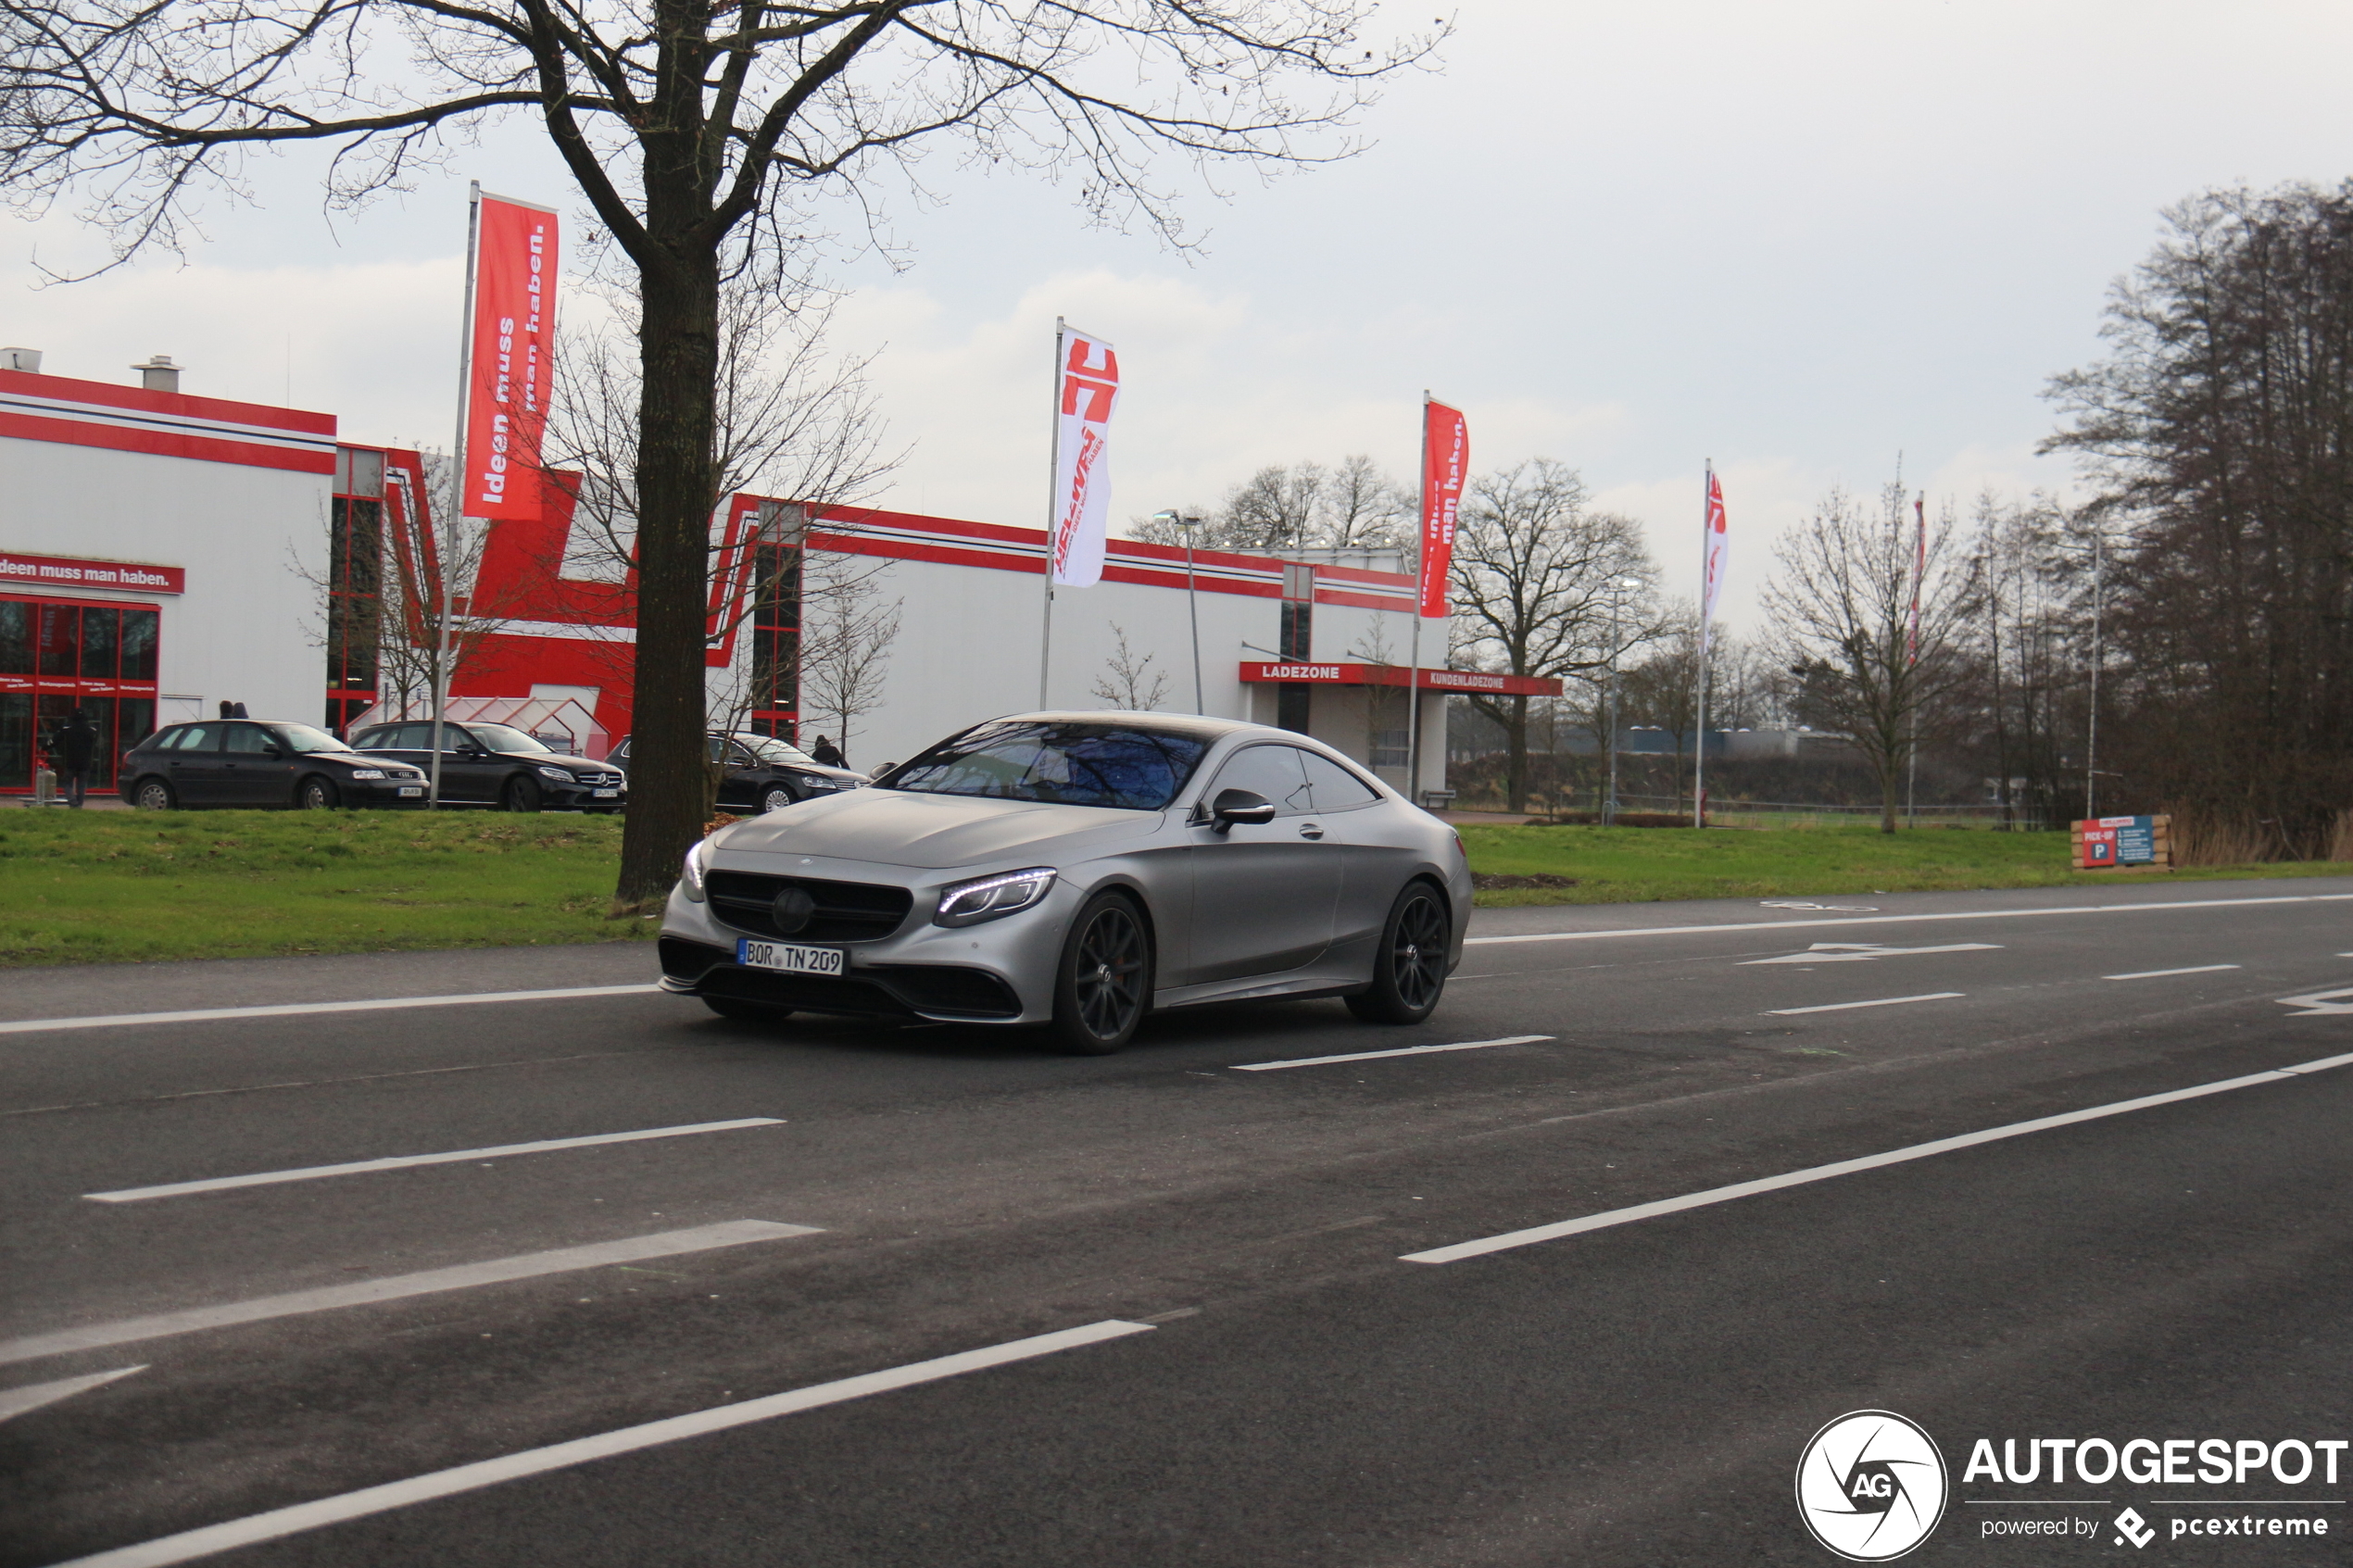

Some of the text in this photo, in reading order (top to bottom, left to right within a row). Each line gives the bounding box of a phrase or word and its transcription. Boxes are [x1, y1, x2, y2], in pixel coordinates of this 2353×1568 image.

[524, 225, 544, 412] man haben.
[482, 317, 514, 504] Ideen muss
[1088, 438, 1105, 466] HABEN
[1442, 497, 1456, 545] man
[40, 564, 82, 580] muss
[84, 568, 117, 583] man
[120, 568, 170, 586] haben.
[1262, 665, 1340, 679] LADEZONE
[1429, 671, 1504, 689] KUNDENLADEZONE
[2084, 831, 2114, 842] PICK-UP
[2095, 844, 2105, 859] P
[747, 943, 840, 972] BOR TN 209
